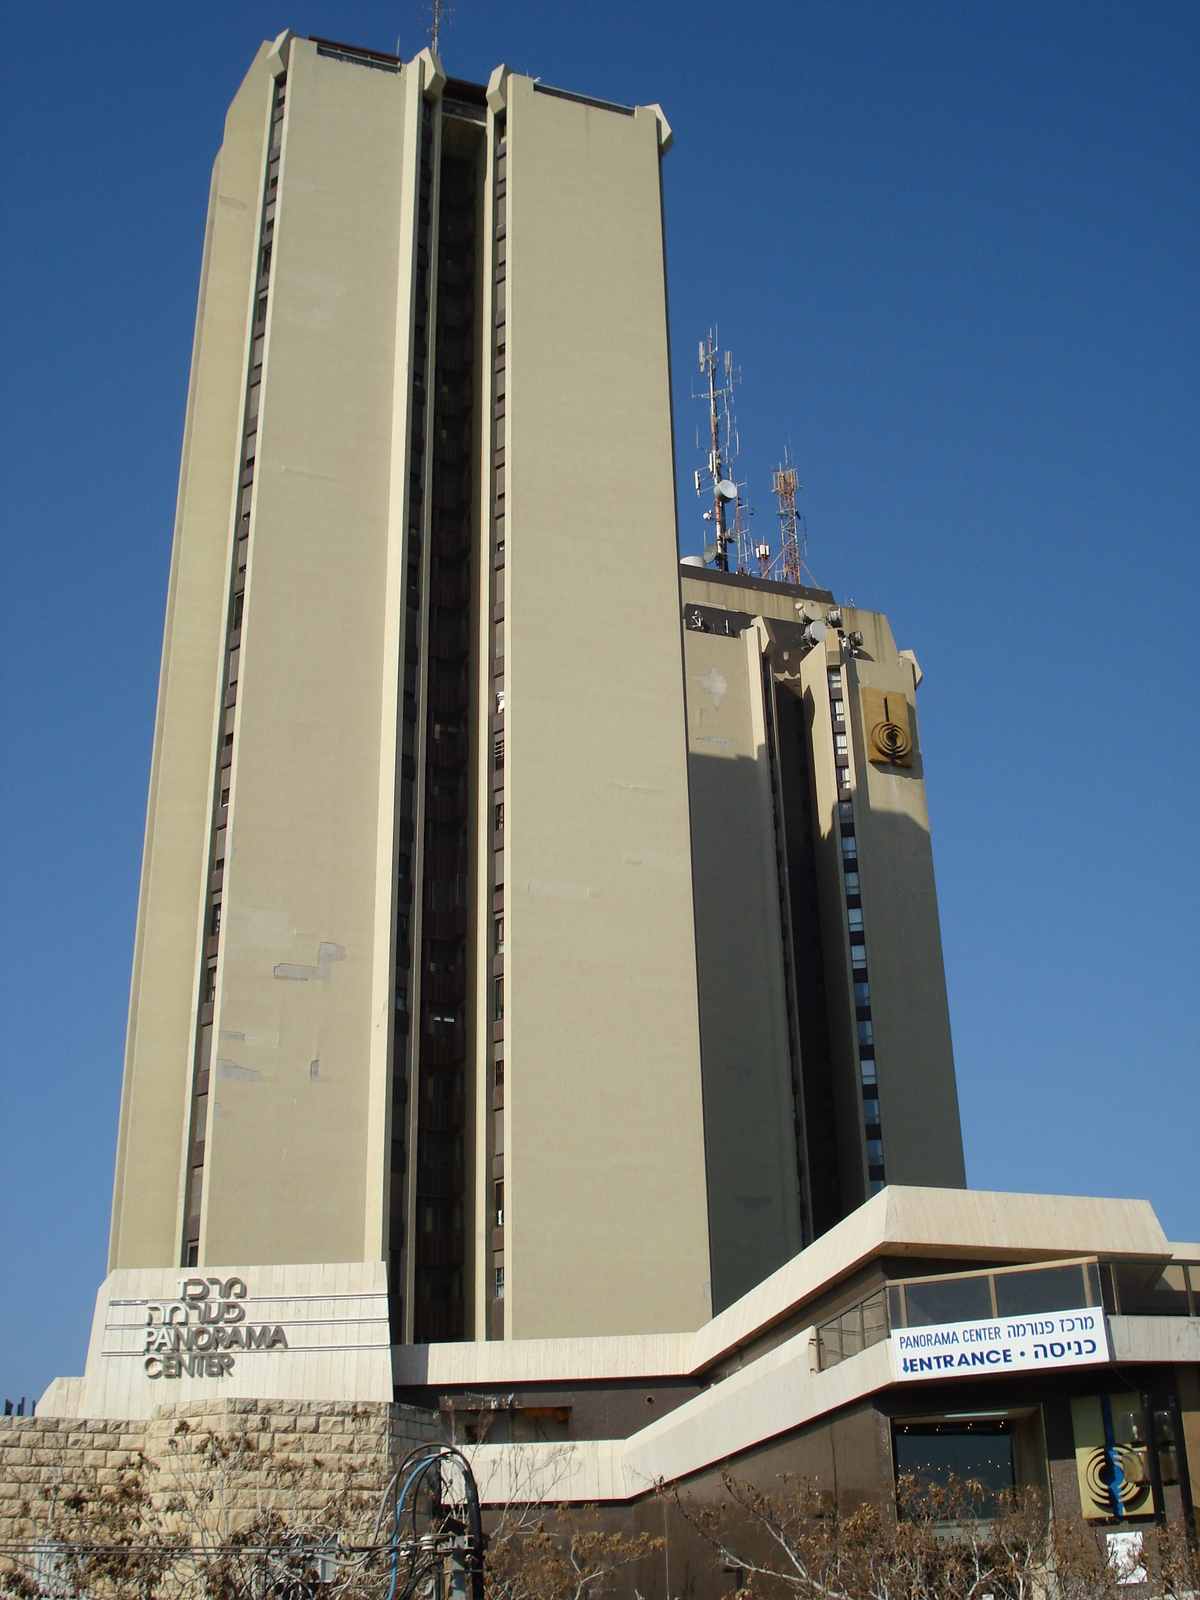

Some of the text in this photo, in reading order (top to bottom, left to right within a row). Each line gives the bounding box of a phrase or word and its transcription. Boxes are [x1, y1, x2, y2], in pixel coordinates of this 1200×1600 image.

[177, 1276, 248, 1301] מרכז
[146, 1301, 246, 1326] פנורמה
[144, 1325, 289, 1352] PANORAMA
[899, 1326, 1002, 1350] PANORAMA CENTER
[1007, 1315, 1095, 1338] מרכז פנורמה
[909, 1348, 1013, 1373] ENTRANCE
[1033, 1338, 1097, 1359] כניסה
[144, 1352, 236, 1379] CENTER
